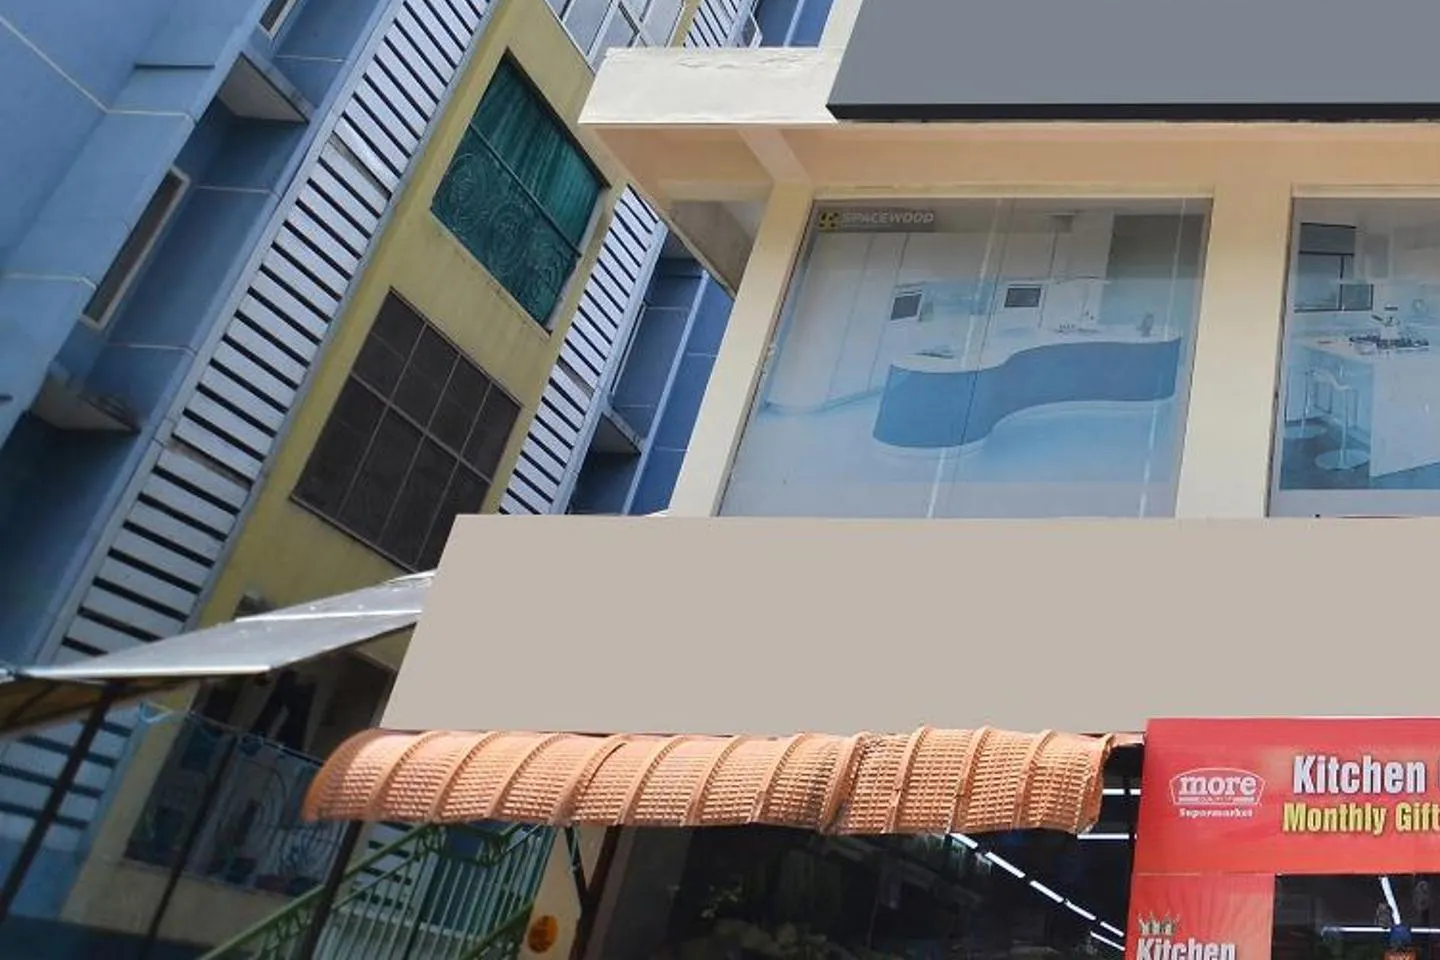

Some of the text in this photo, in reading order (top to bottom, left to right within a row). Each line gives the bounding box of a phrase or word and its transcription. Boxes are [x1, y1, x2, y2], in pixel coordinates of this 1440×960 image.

[1179, 776, 1257, 796] more
[1292, 755, 1426, 794] Kitchen
[1179, 807, 1253, 819] Supermarket
[1282, 801, 1387, 834] Monthly
[1135, 937, 1236, 960] Kitchen
